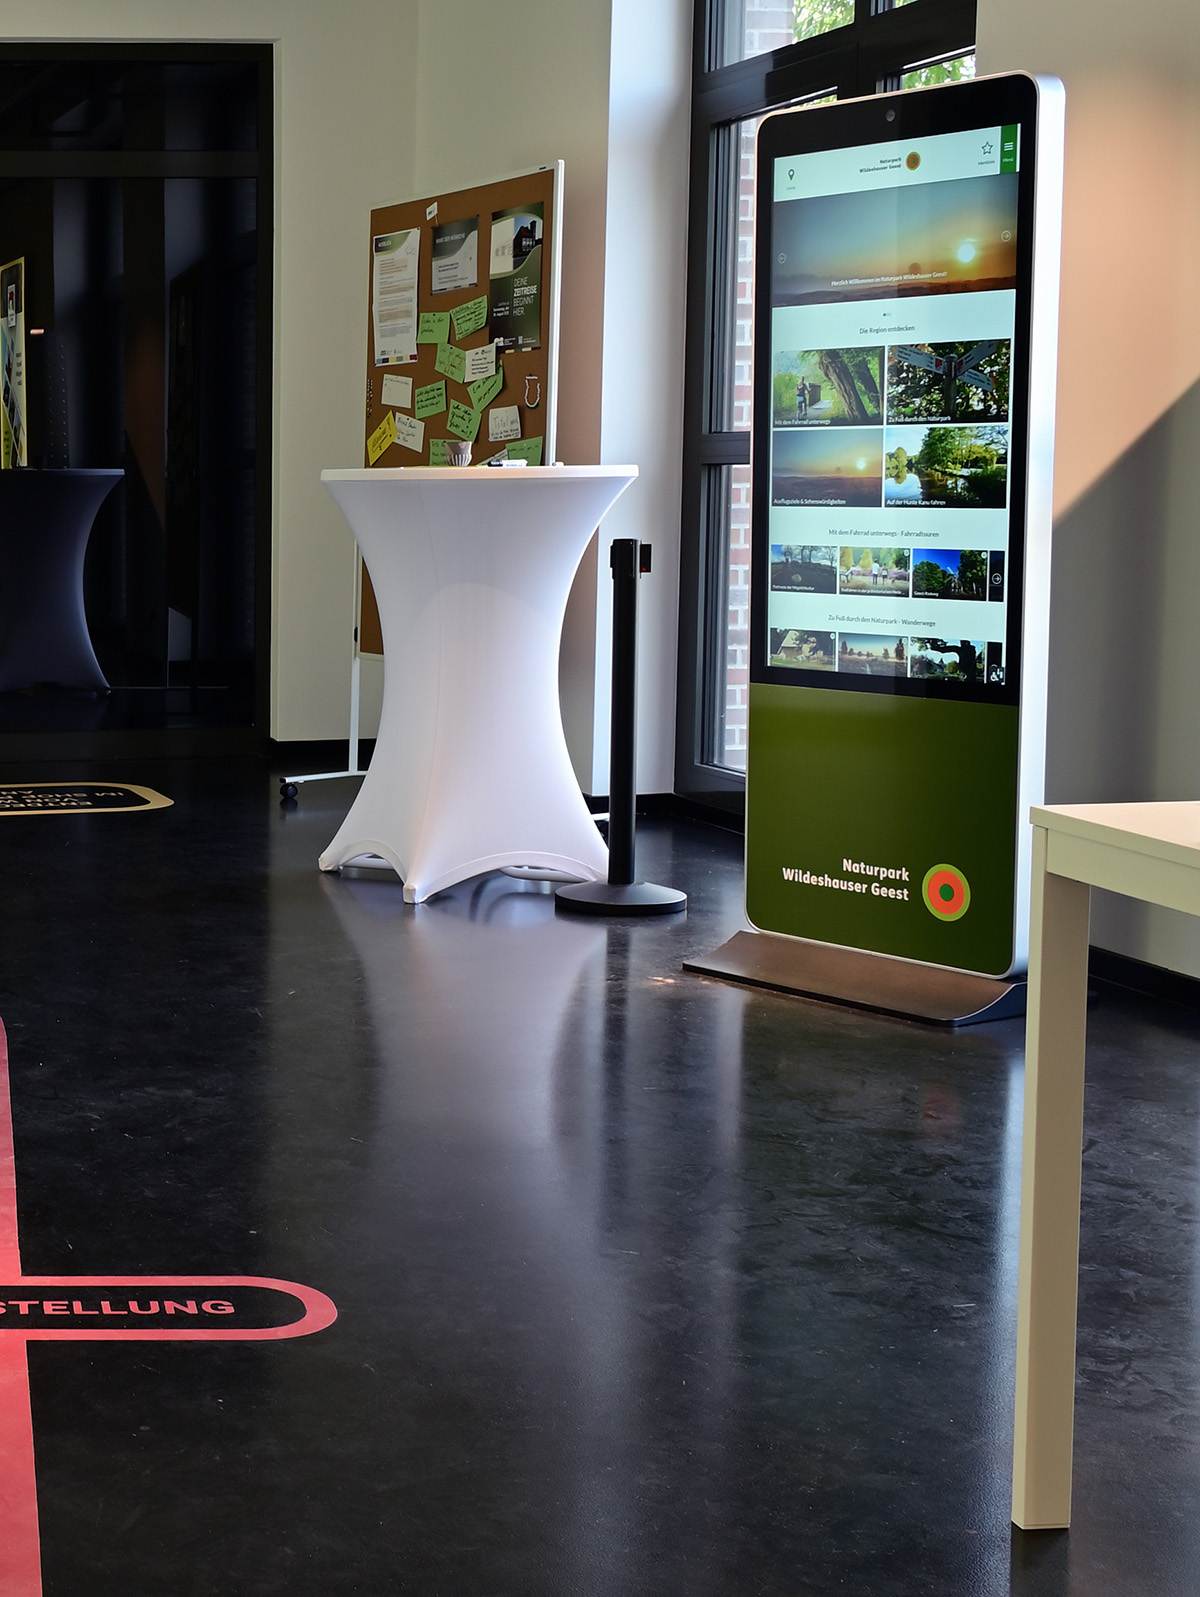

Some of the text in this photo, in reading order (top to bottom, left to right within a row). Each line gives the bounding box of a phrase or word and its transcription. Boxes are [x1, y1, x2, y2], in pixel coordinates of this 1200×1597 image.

[514, 277, 528, 287] DEINE
[514, 285, 537, 297] ZEITREISE
[513, 296, 534, 307] BEGINNT
[512, 307, 524, 316] HIER
[901, 619, 936, 627] Wanderwege
[843, 858, 909, 881] Naturpark
[782, 868, 909, 901] Wildeshauser Geest
